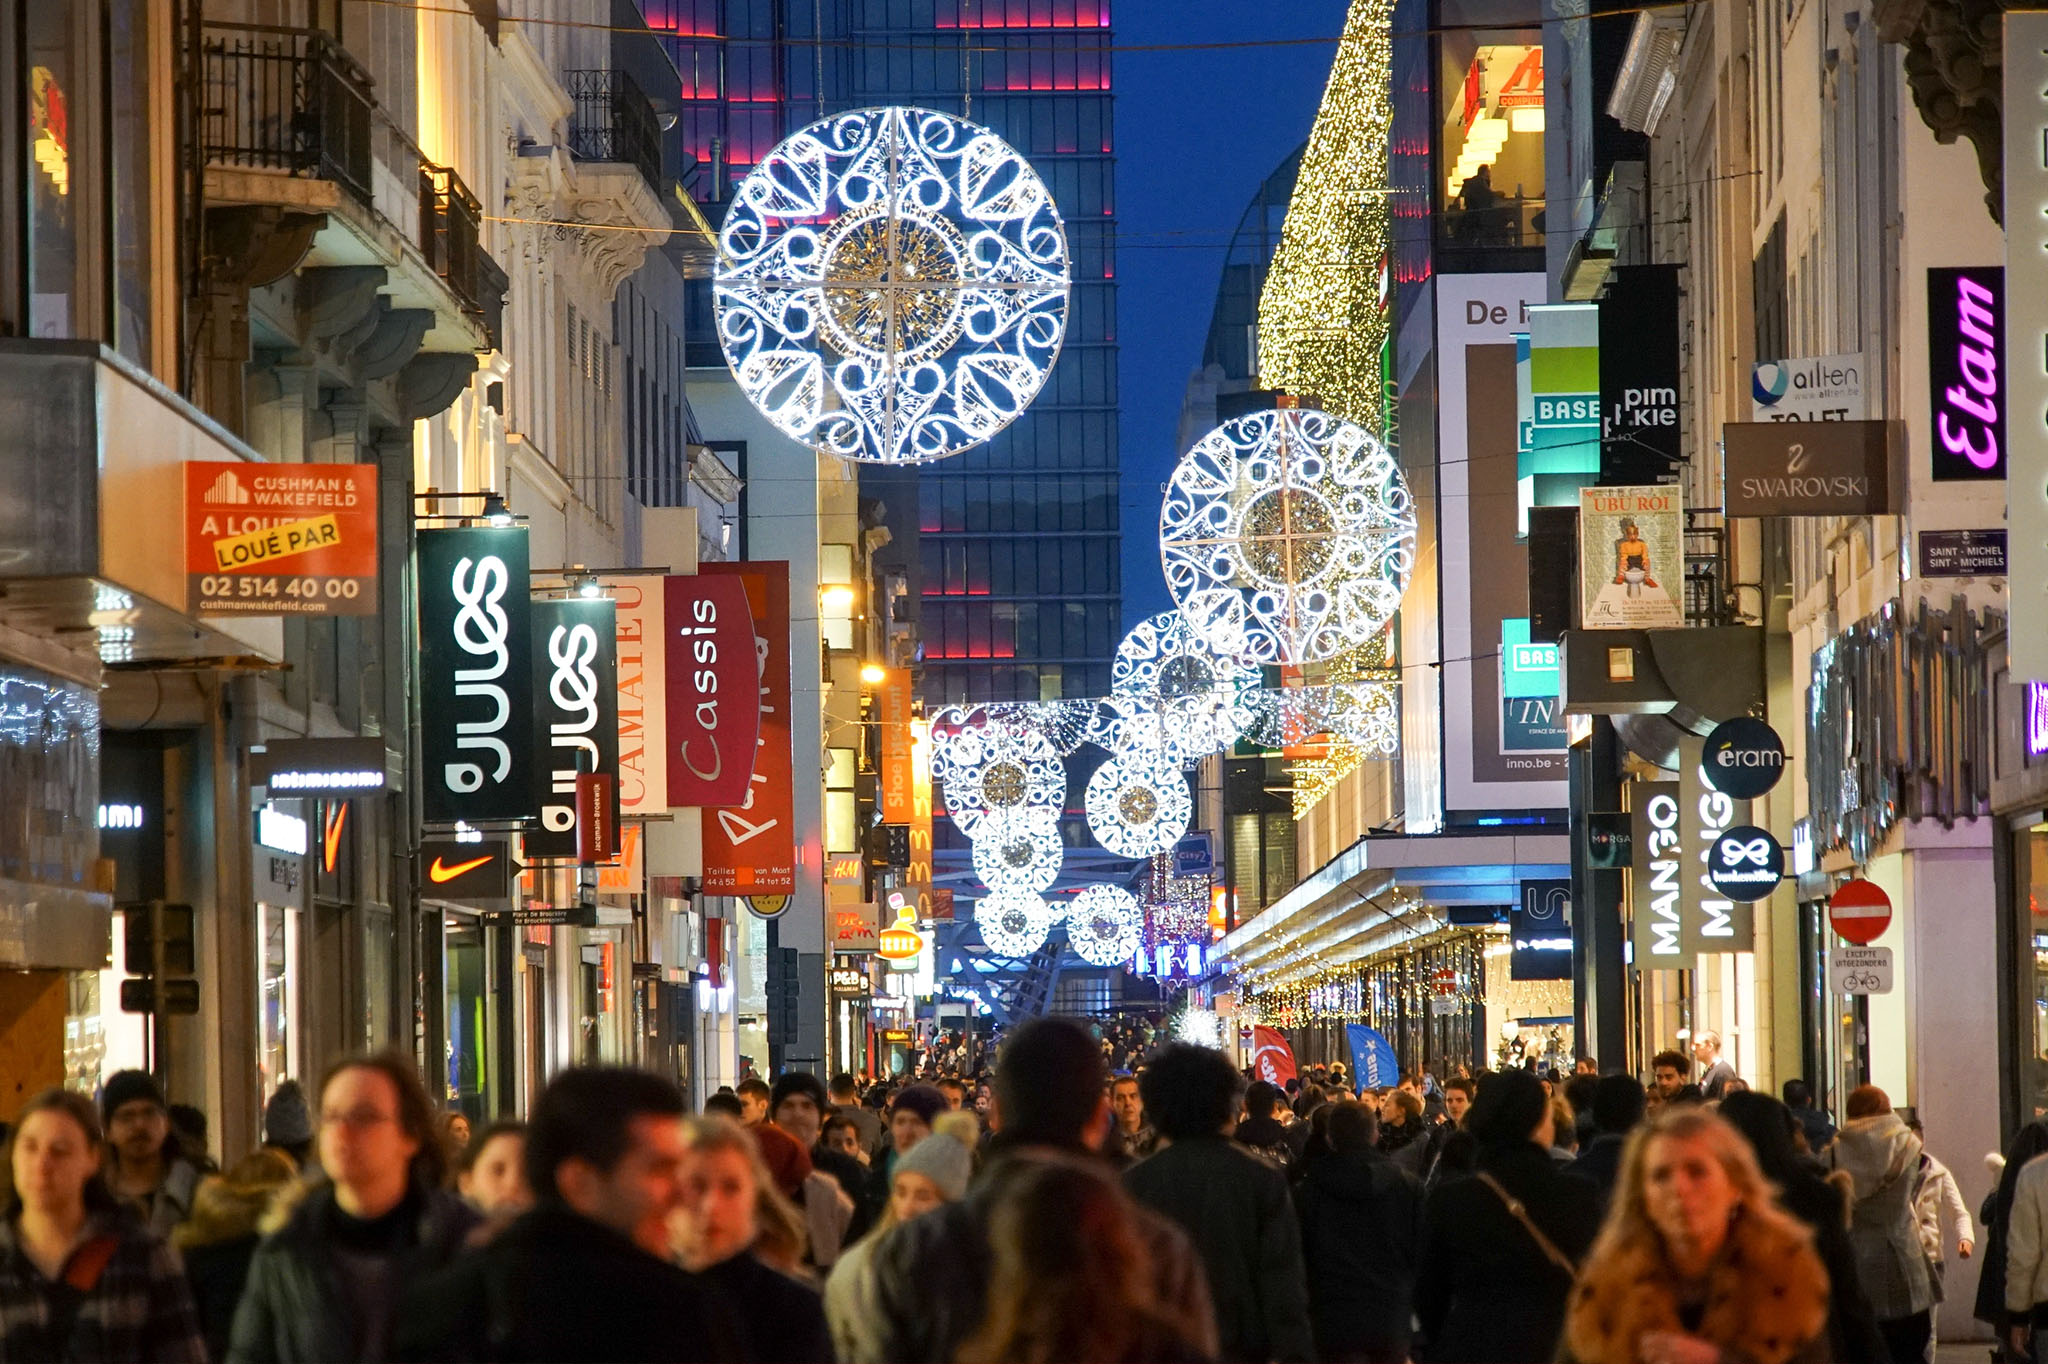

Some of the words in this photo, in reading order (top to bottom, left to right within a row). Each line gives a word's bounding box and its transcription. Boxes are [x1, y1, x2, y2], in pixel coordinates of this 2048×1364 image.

[1466, 300, 1508, 325] De
[1938, 276, 1998, 470] Etam
[1625, 387, 1676, 411] pim
[1540, 400, 1600, 420] BASE
[253, 477, 339, 491] CUSHMAN
[344, 478, 356, 492] &
[1741, 477, 1869, 499] SWAROVSKI
[253, 492, 357, 507] WAKEFIELD
[1593, 497, 1632, 513] UBU
[1637, 496, 1669, 511] ROI
[200, 516, 219, 536] A
[218, 531, 281, 567] LOUÉ
[288, 523, 336, 551] PAR
[1929, 547, 1958, 557] SAINT
[1966, 546, 2003, 556] MICHEL
[1929, 558, 1951, 568] SINT
[1960, 557, 2005, 567] MICHIELS
[201, 576, 232, 596] 02
[239, 577, 278, 597] 514
[285, 578, 318, 598] 40
[325, 579, 359, 599] 00
[200, 600, 327, 612] cushmanwakefield.com
[681, 598, 721, 782] Cassis
[1506, 758, 1551, 769] inno.be
[1717, 741, 1782, 768] éram
[887, 763, 904, 808] Shoe
[707, 867, 735, 875] Tailles
[771, 866, 791, 874] Maat
[1648, 794, 1681, 955] MANGO
[707, 878, 717, 886] 44
[725, 878, 736, 886] 52
[781, 877, 791, 885] 52
